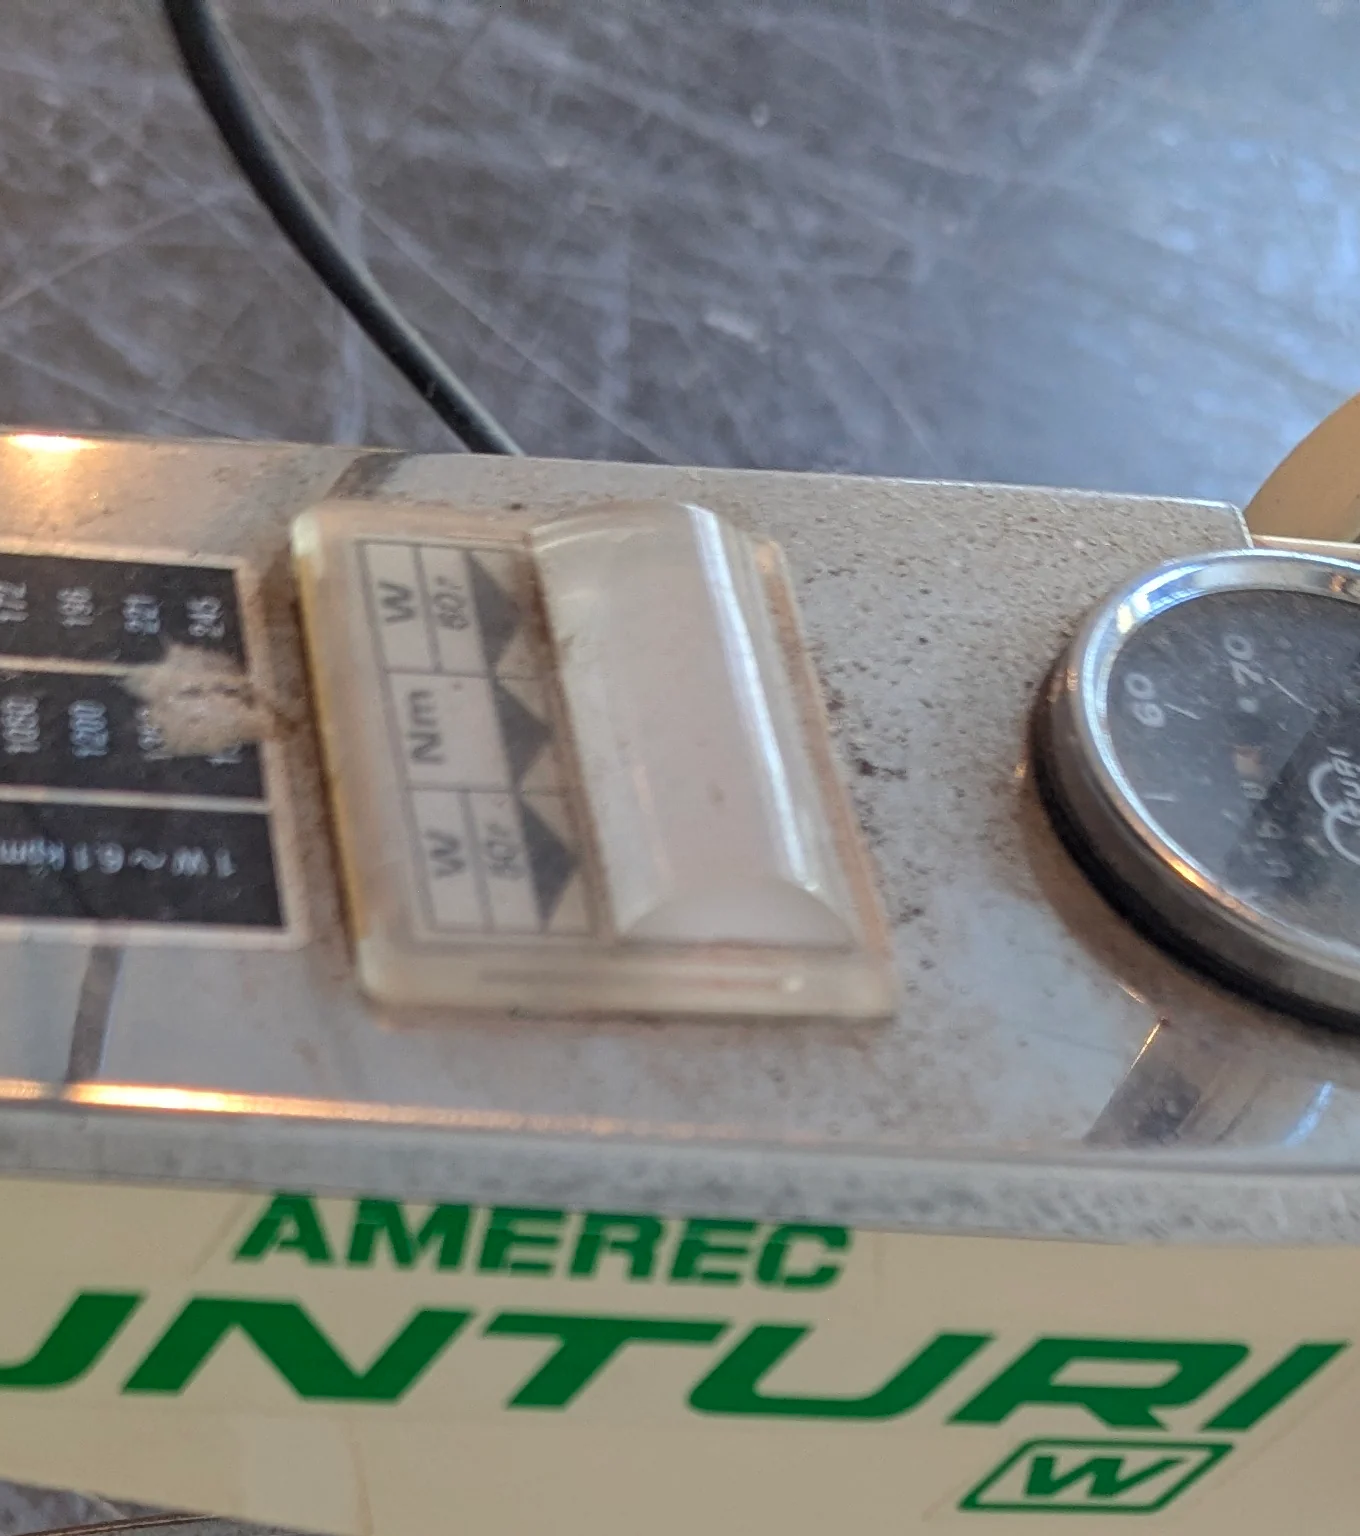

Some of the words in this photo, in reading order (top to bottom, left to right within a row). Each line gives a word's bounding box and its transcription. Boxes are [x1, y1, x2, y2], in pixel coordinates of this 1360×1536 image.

[377, 580, 415, 624] W
[1221, 631, 1265, 688] 70
[1123, 671, 1169, 729] 60
[68, 699, 110, 758] 1200
[408, 689, 446, 766] Nm
[170, 845, 209, 877] W
[214, 847, 236, 878] 1
[426, 829, 468, 879] W
[234, 1192, 851, 1292] AMEREC
[1021, 1453, 1188, 1500] W
